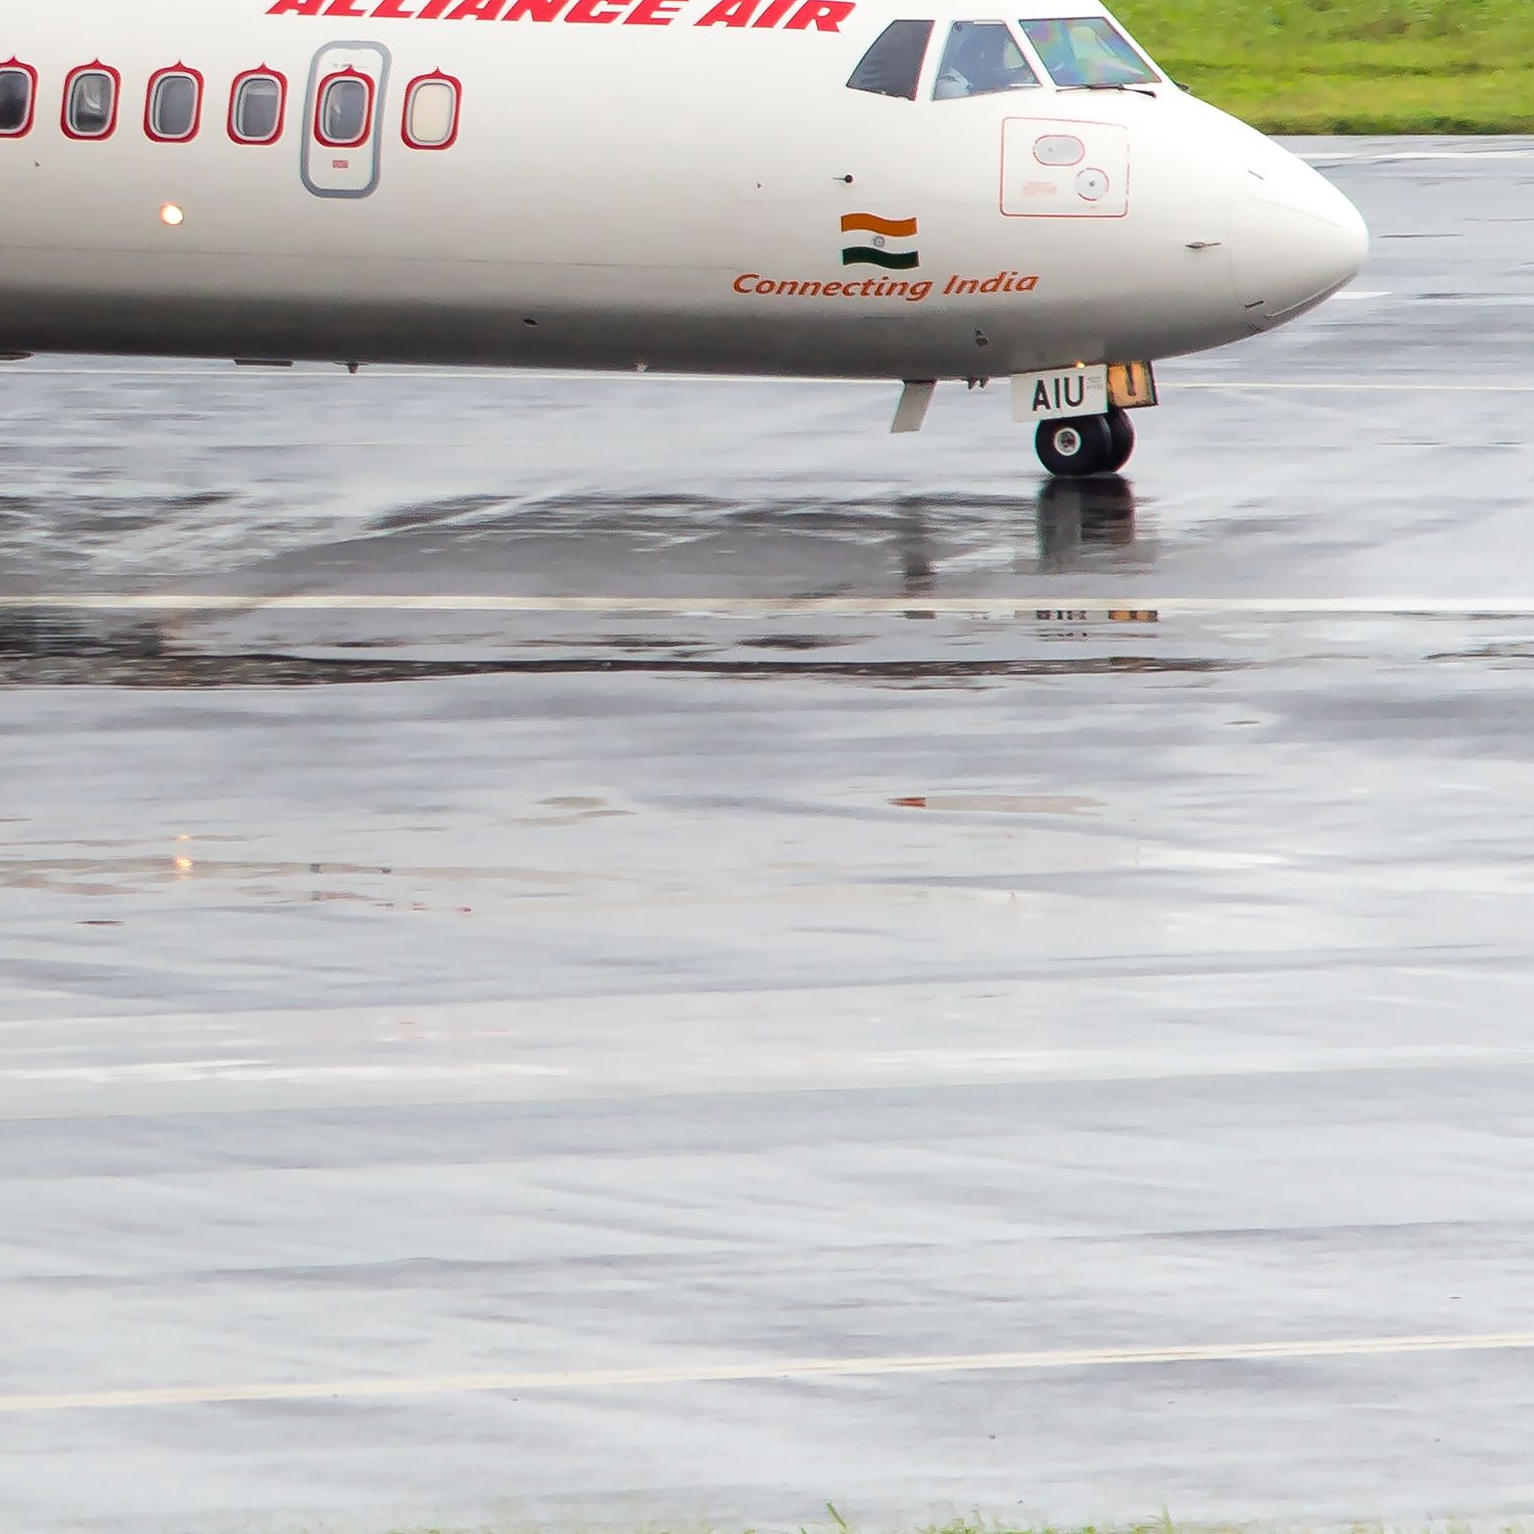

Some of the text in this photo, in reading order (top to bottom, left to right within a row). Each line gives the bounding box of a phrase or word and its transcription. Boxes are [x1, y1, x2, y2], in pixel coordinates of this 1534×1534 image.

[732, 270, 1040, 302] Connecting India
[1032, 375, 1084, 412] AIU
